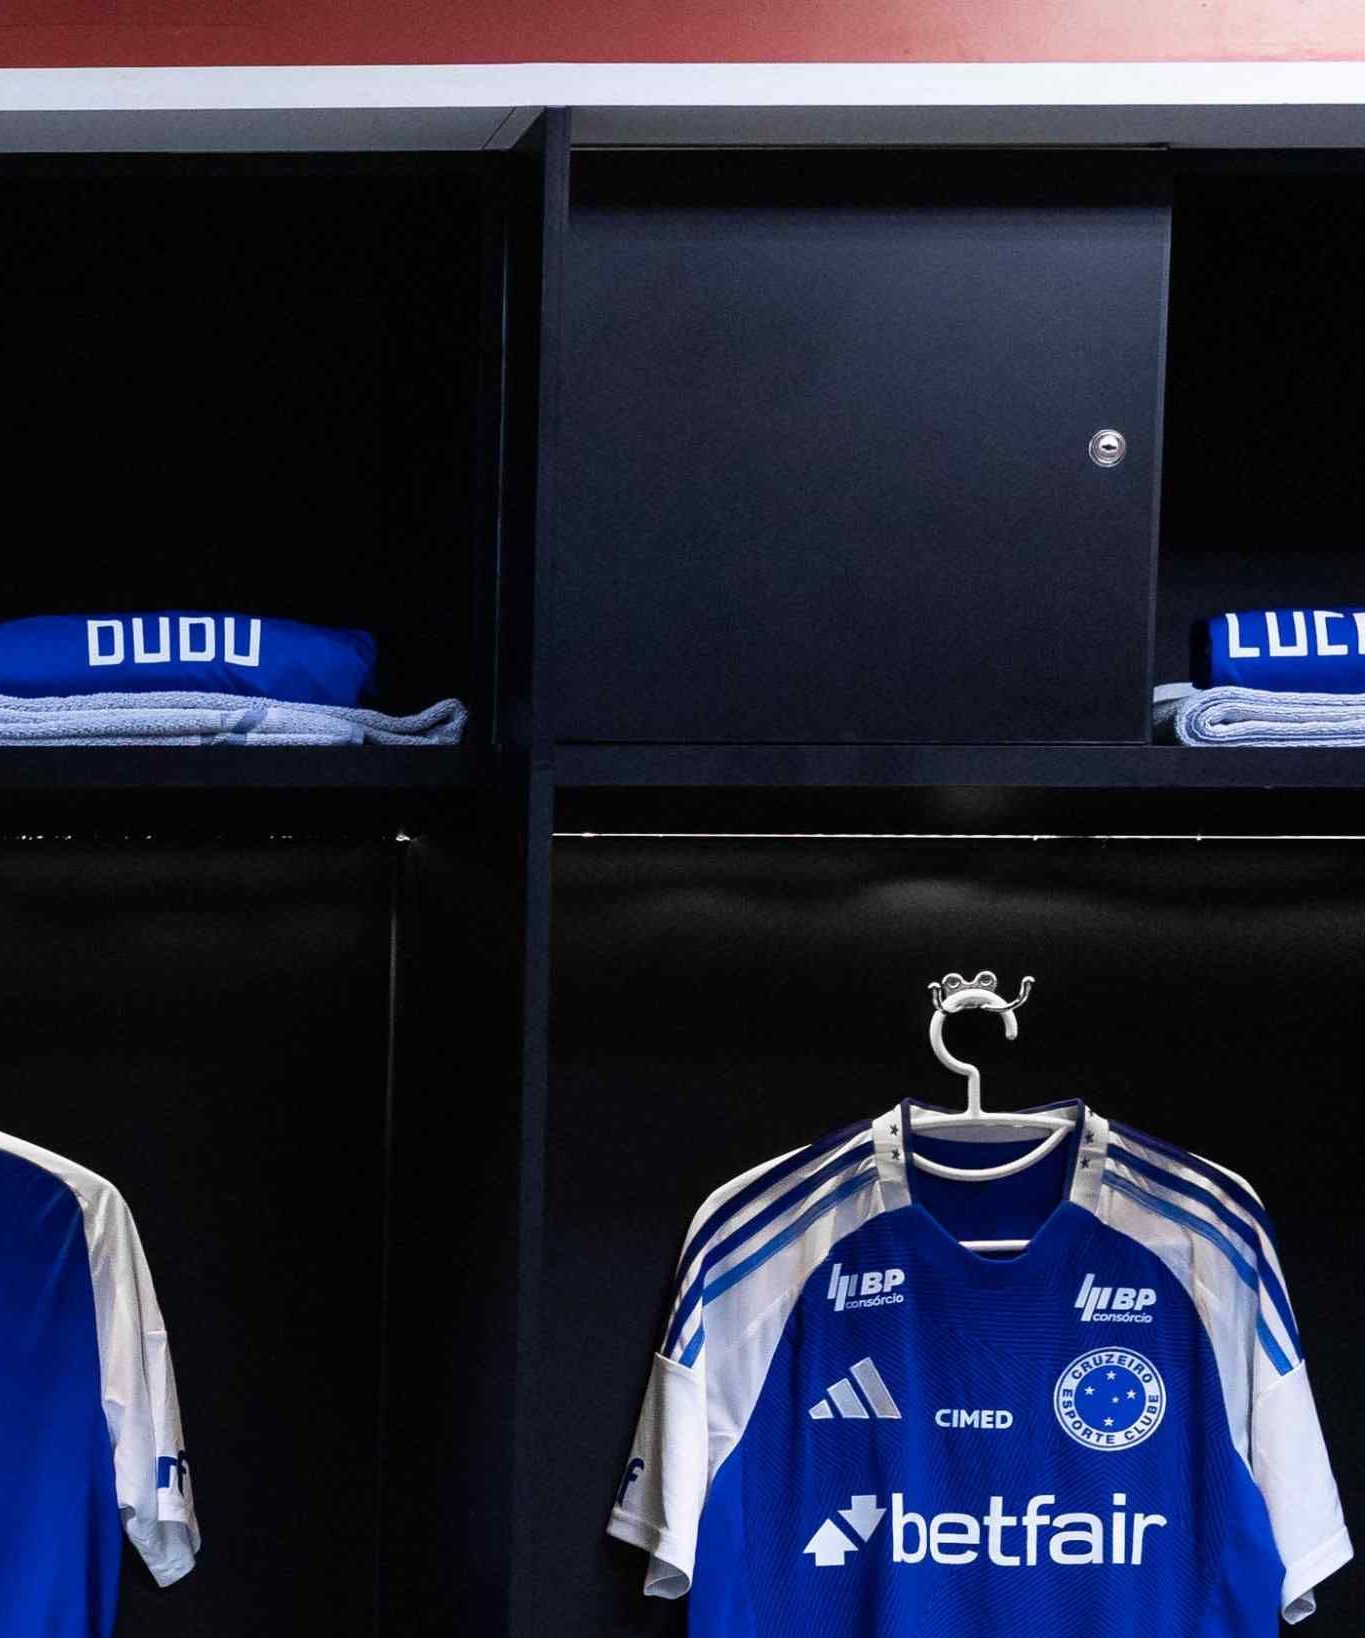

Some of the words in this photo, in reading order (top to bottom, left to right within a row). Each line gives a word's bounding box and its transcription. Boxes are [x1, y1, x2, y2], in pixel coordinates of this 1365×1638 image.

[87, 617, 261, 667] DUDU
[845, 1293, 904, 1309] consórcio
[1092, 1312, 1152, 1323] consórcio
[1072, 1353, 1152, 1384] CRUZEIRO
[935, 1409, 1013, 1429] CIMED
[1062, 1388, 1115, 1444] ESPORTE
[1124, 1394, 1159, 1441] CLUBE
[892, 1492, 1167, 1566] betfair
